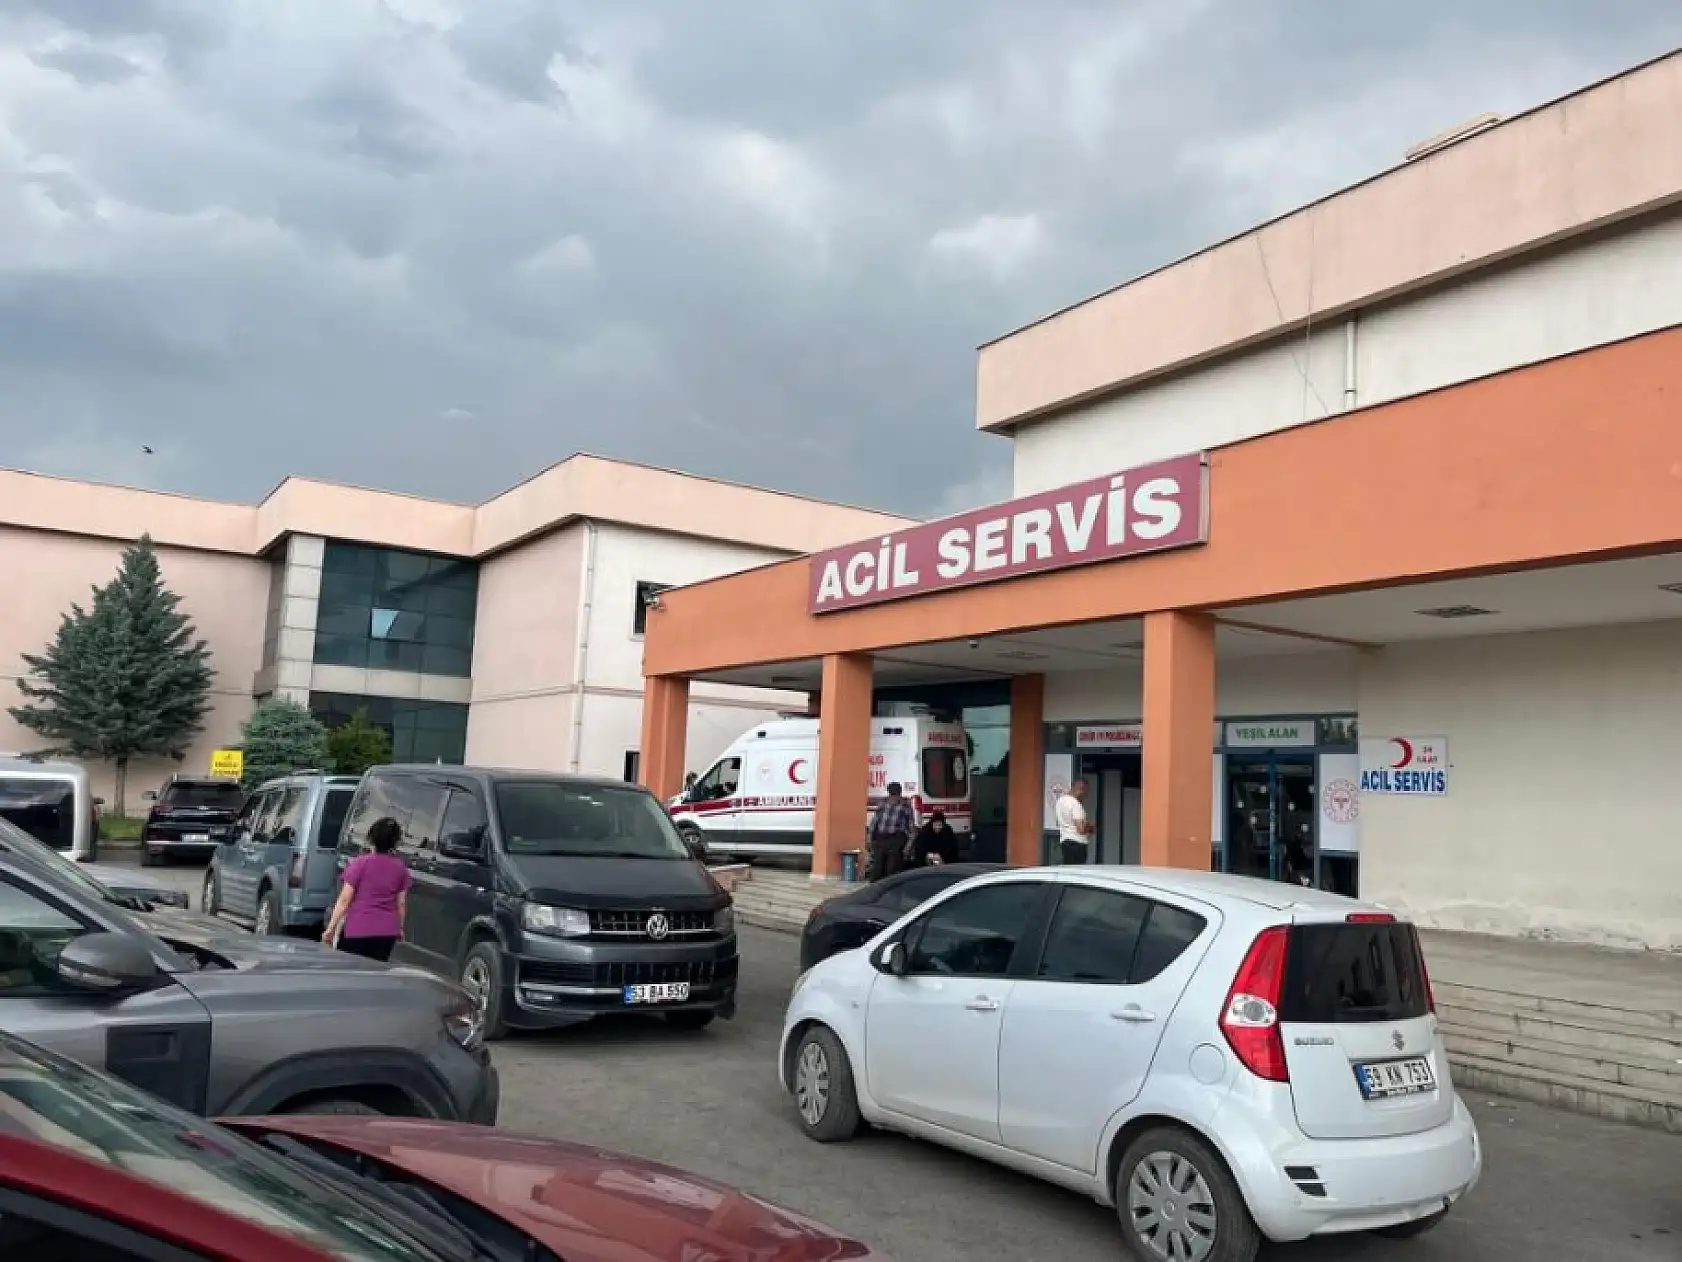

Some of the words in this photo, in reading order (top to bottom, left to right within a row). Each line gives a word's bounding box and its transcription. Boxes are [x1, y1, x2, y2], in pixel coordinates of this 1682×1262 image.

[816, 535, 919, 603] ACİL
[936, 474, 1182, 579] SERVİS
[1267, 727, 1298, 739] ALAN
[1361, 767, 1392, 790] ACİL
[1394, 767, 1445, 792] SERVİS
